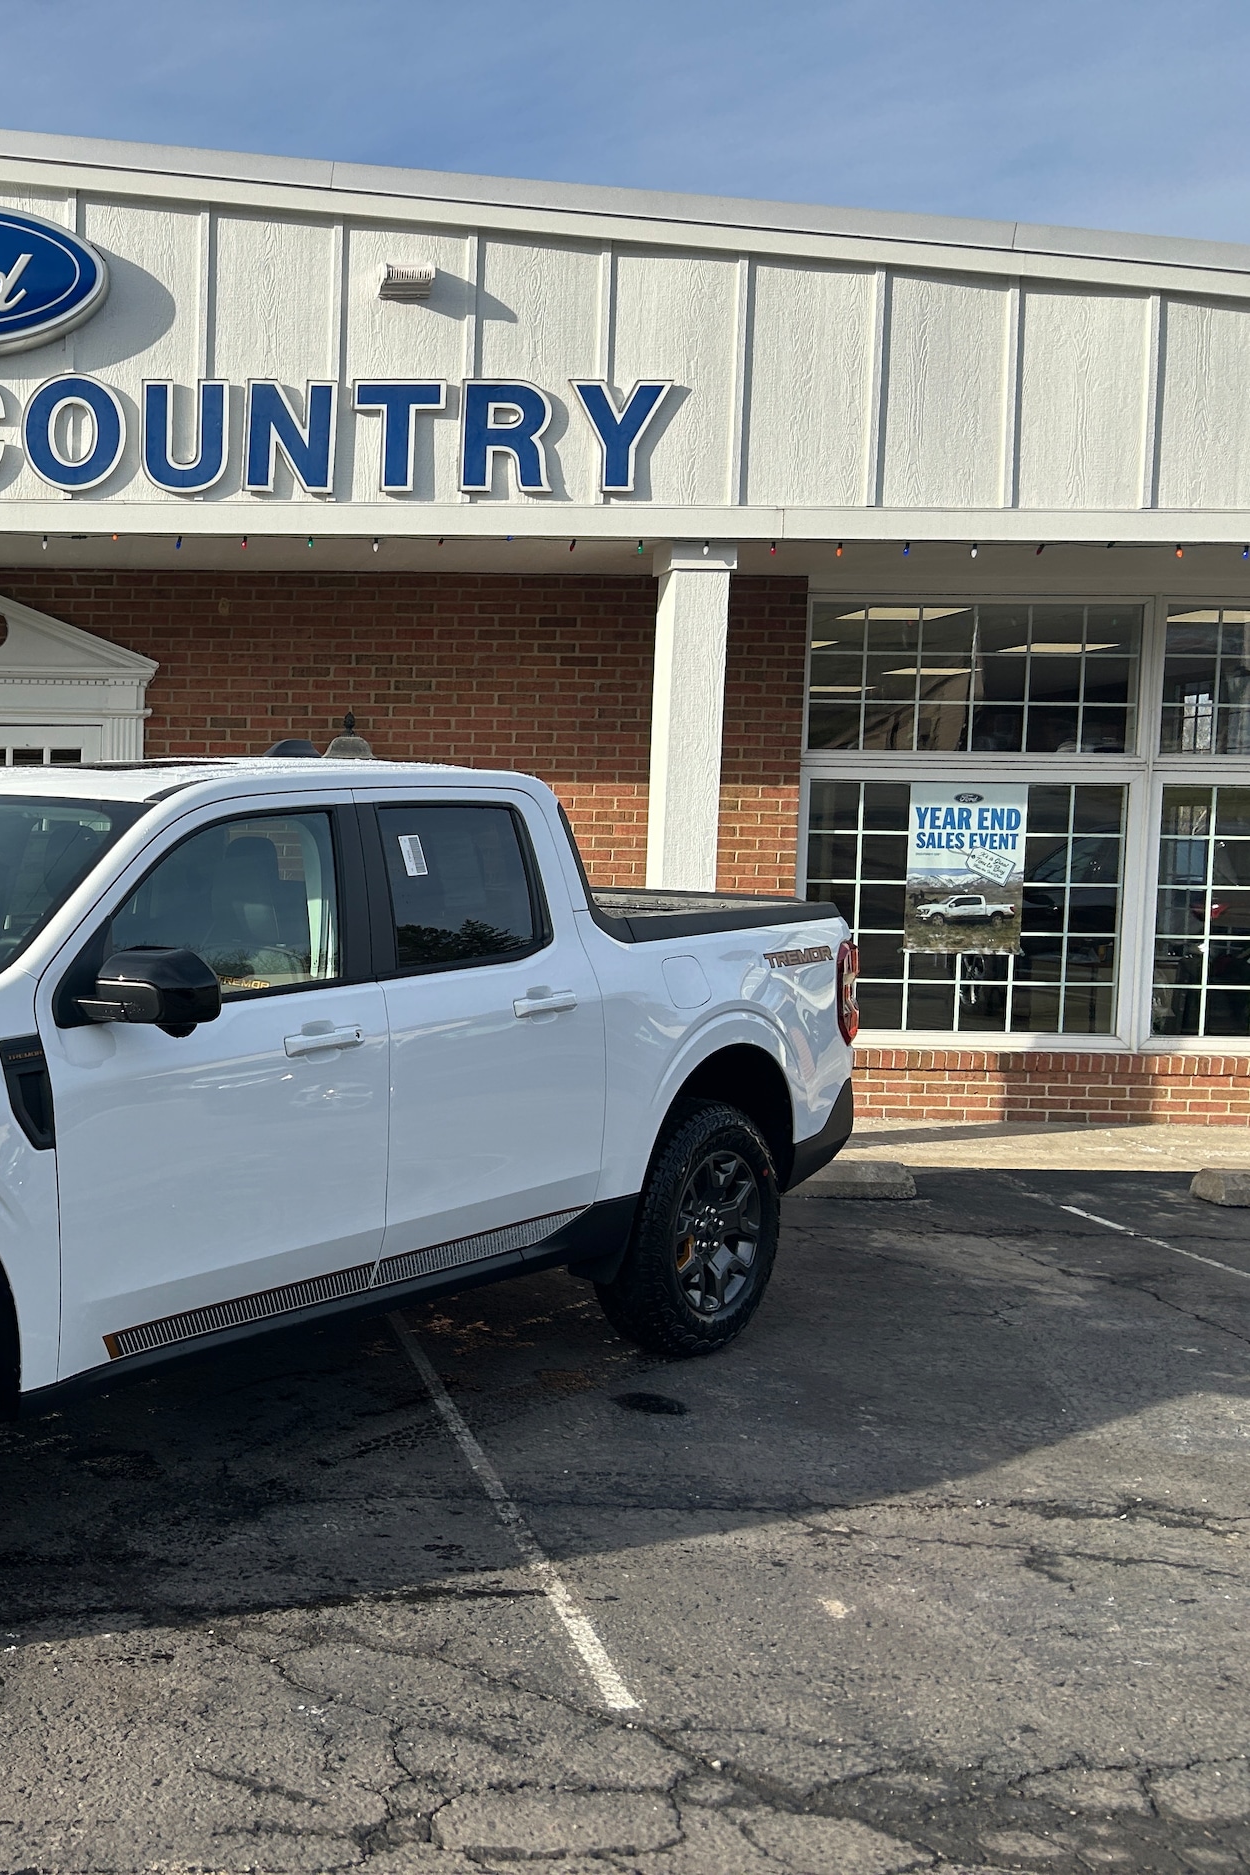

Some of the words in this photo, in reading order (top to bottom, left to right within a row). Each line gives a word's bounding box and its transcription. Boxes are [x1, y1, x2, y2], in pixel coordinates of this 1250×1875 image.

[915, 807, 972, 830] YEAR
[977, 807, 1021, 831] END
[915, 831, 965, 849] SALES
[969, 832, 1019, 850] EVENT
[763, 945, 834, 968] TREMOR
